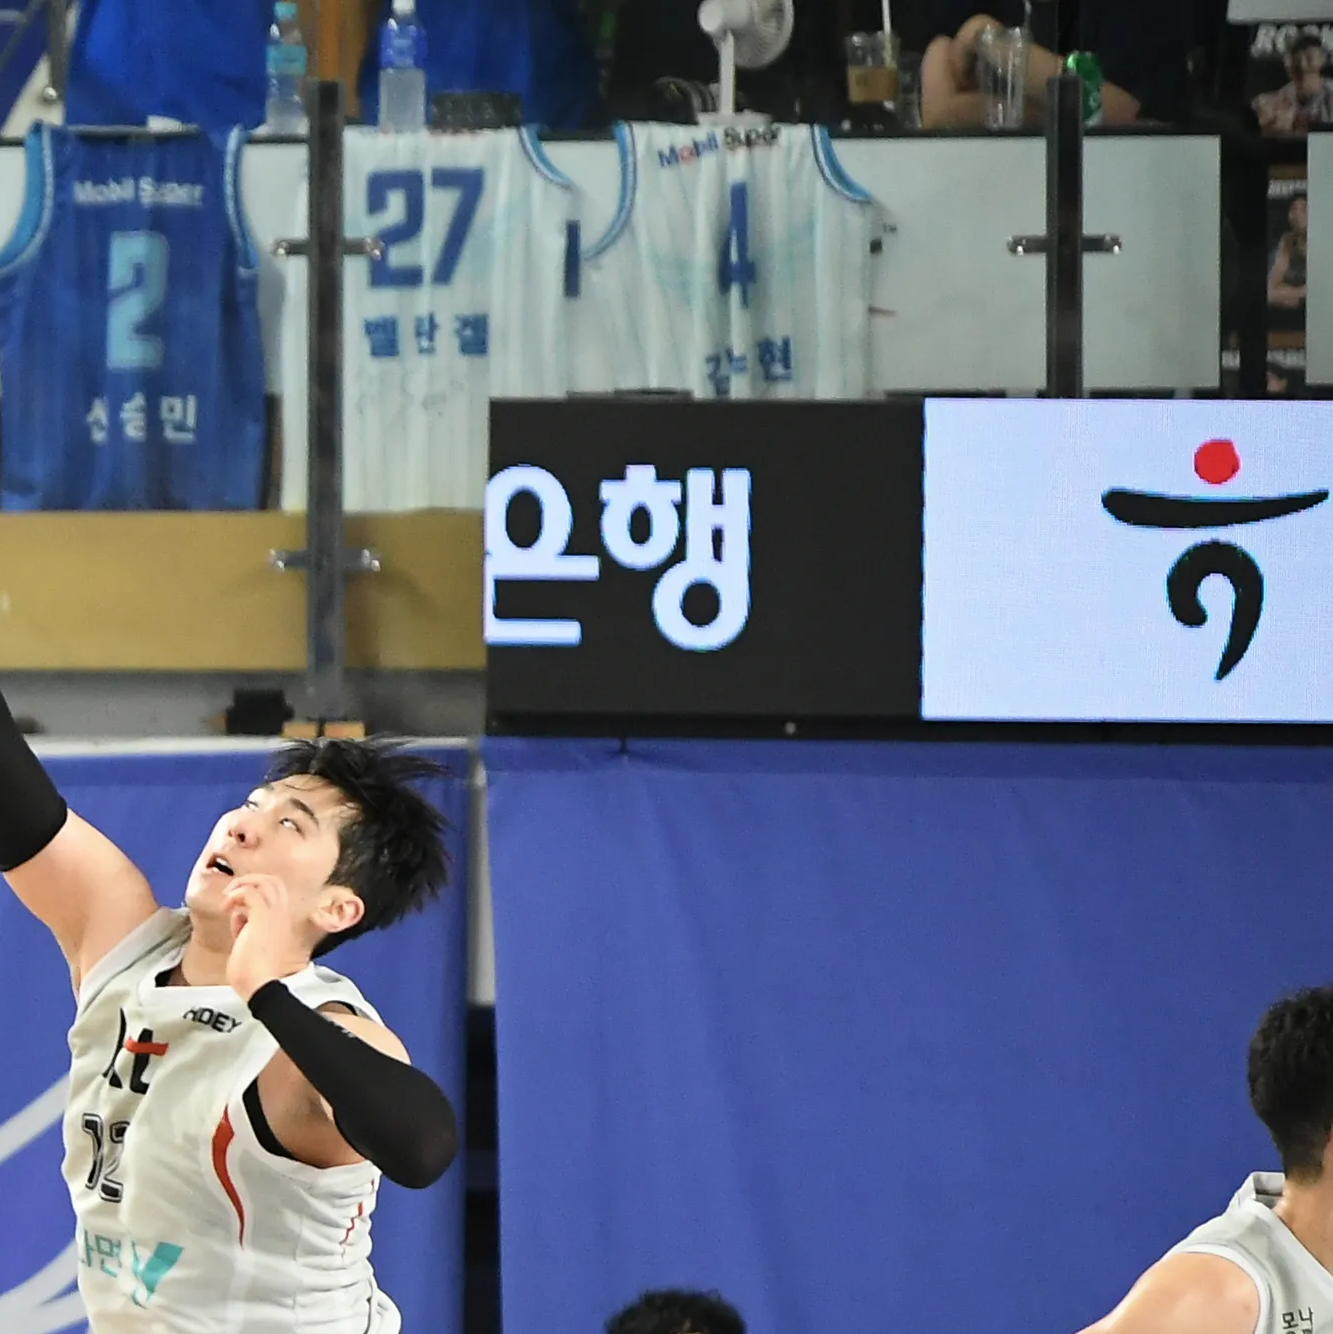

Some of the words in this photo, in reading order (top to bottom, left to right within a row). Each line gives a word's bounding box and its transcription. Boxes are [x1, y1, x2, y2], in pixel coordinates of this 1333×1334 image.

[366, 166, 485, 288] 27
[719, 182, 757, 309] 4
[106, 230, 170, 373] 2
